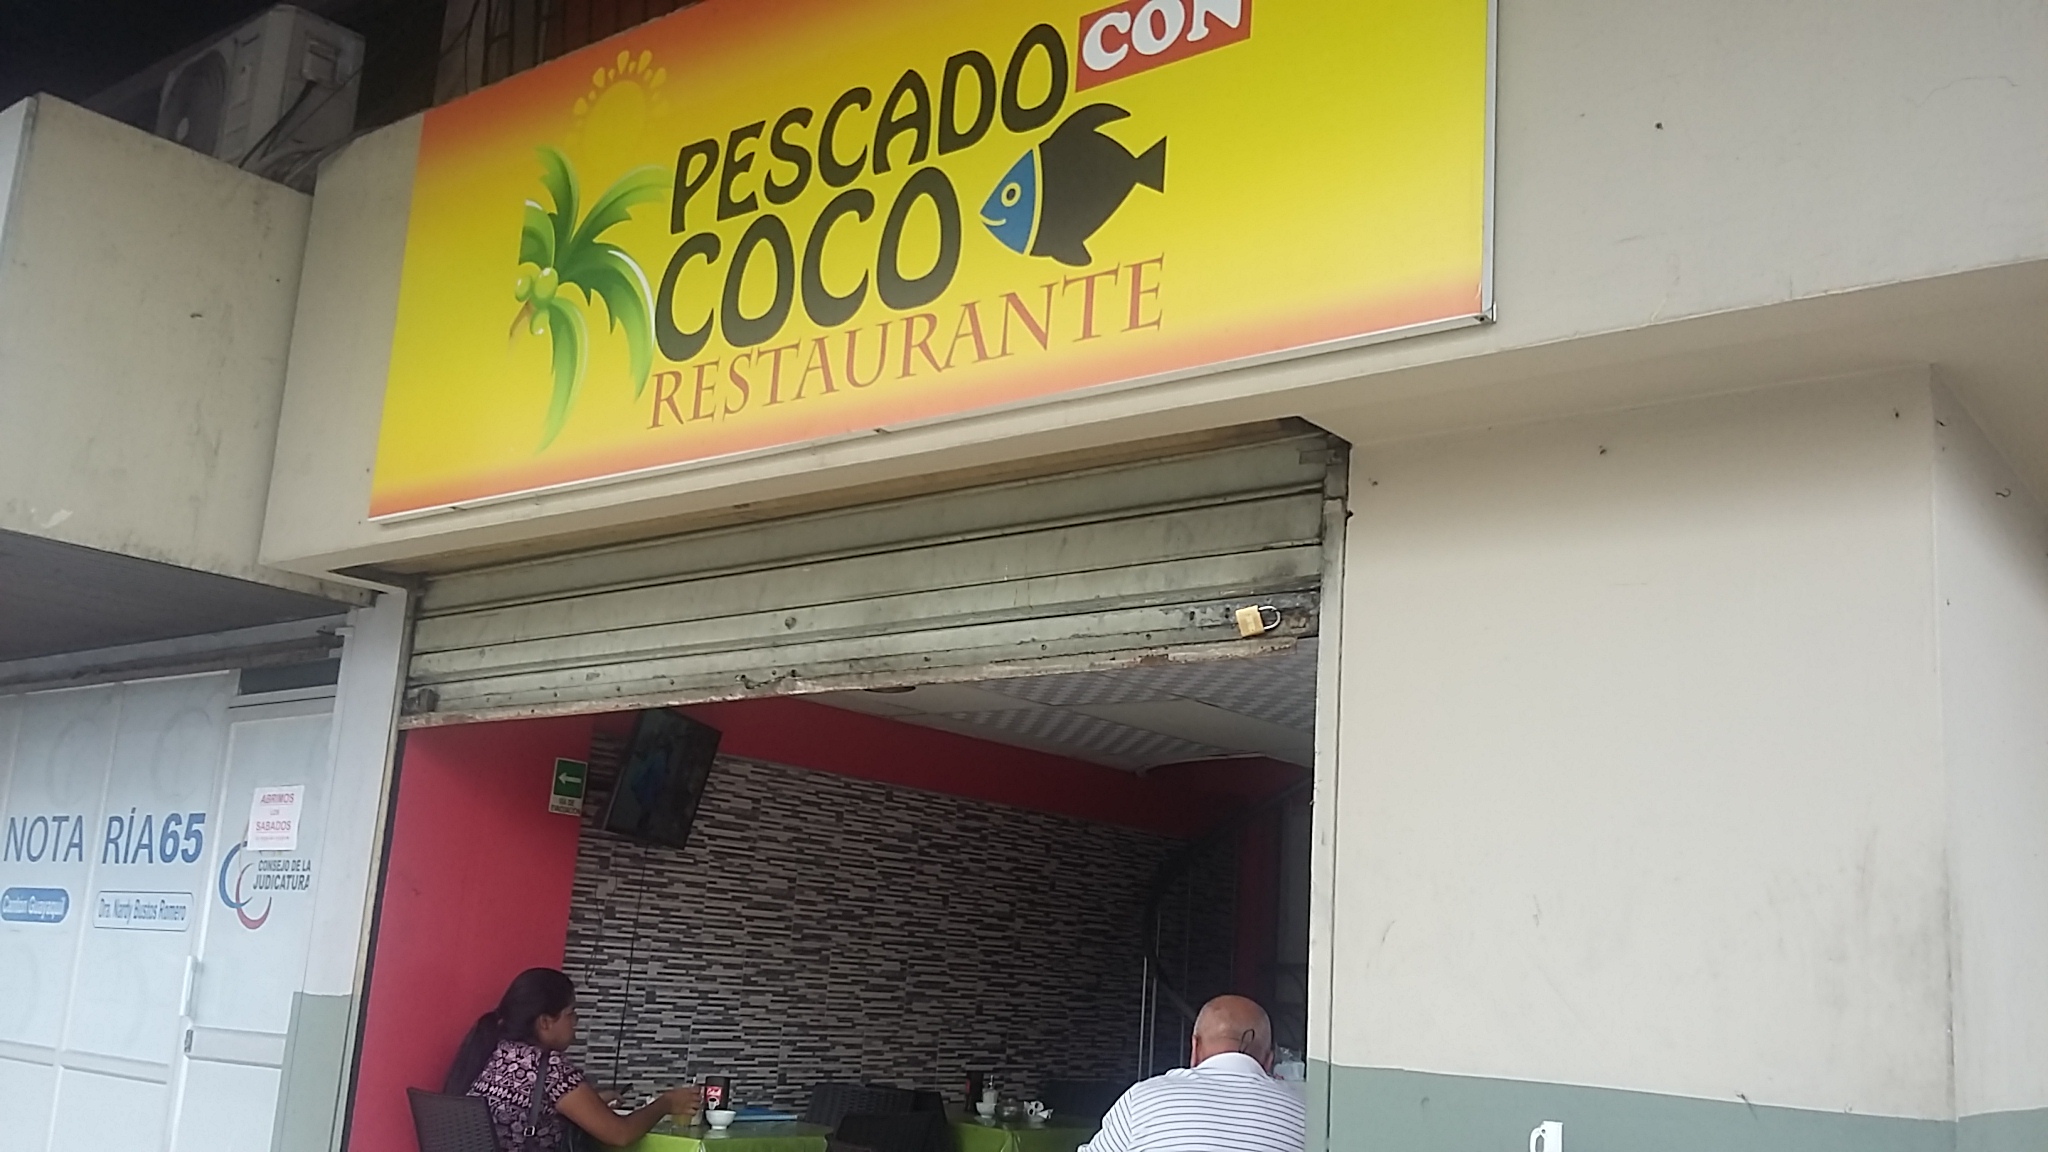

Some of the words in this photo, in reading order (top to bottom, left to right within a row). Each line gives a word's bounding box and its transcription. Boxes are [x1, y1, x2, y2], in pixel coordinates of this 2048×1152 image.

[669, 23, 1069, 234] PESCADO
[1082, 0, 1242, 71] CON
[654, 166, 962, 362] COCO
[648, 253, 1164, 430] RESTAURANTE
[260, 793, 295, 804] ABRIMOS
[3, 815, 84, 863] NOTA
[256, 820, 292, 831] SABADOS
[258, 859, 290, 872] CONSEJO
[291, 859, 301, 872] DE
[302, 859, 311, 872] LA
[252, 874, 311, 891] JUDICATURA
